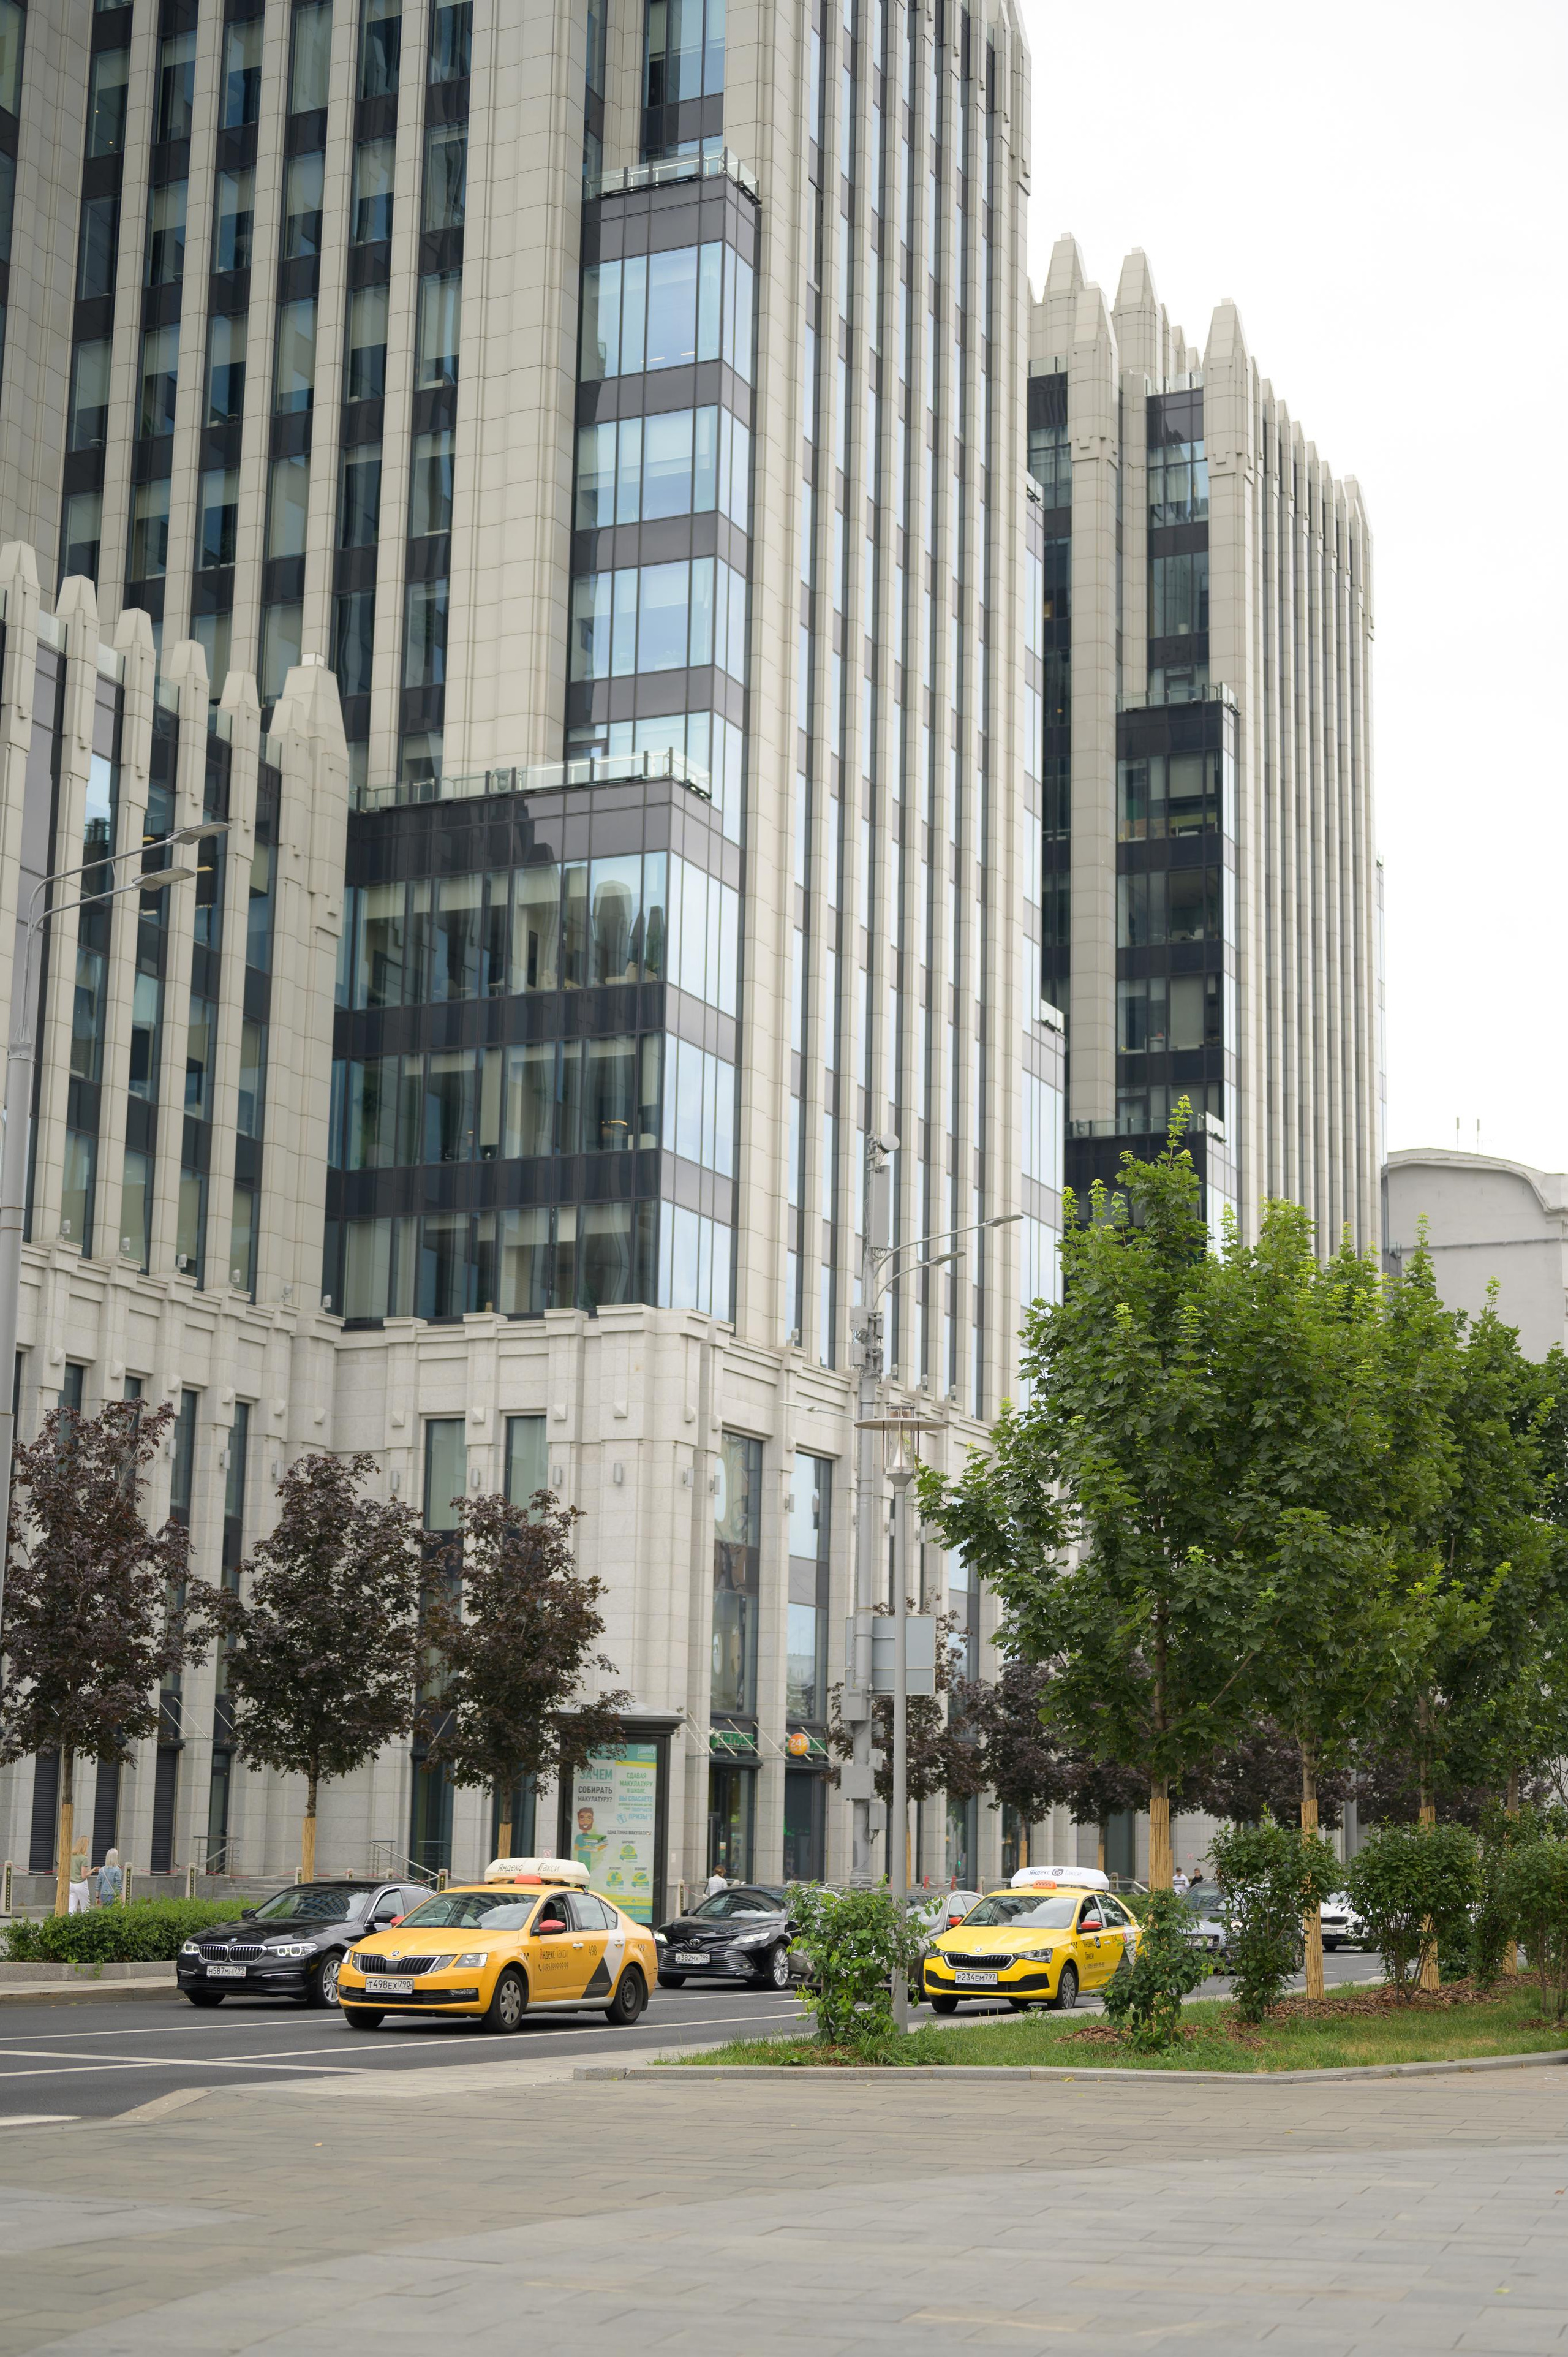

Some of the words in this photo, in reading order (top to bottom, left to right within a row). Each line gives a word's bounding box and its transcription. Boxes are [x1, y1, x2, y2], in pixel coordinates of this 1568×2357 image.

[579, 1769, 612, 1780] ЗАЧЕМ
[578, 1785, 612, 1794] СОБИРАТЬ
[497, 1863, 524, 1873] Яндекс
[538, 1863, 560, 1872] Такси
[540, 1948, 556, 1960] Яндекс
[556, 1947, 568, 1958] Такси
[589, 1945, 597, 1956] 498
[369, 1980, 398, 1989] Т498ЕХ
